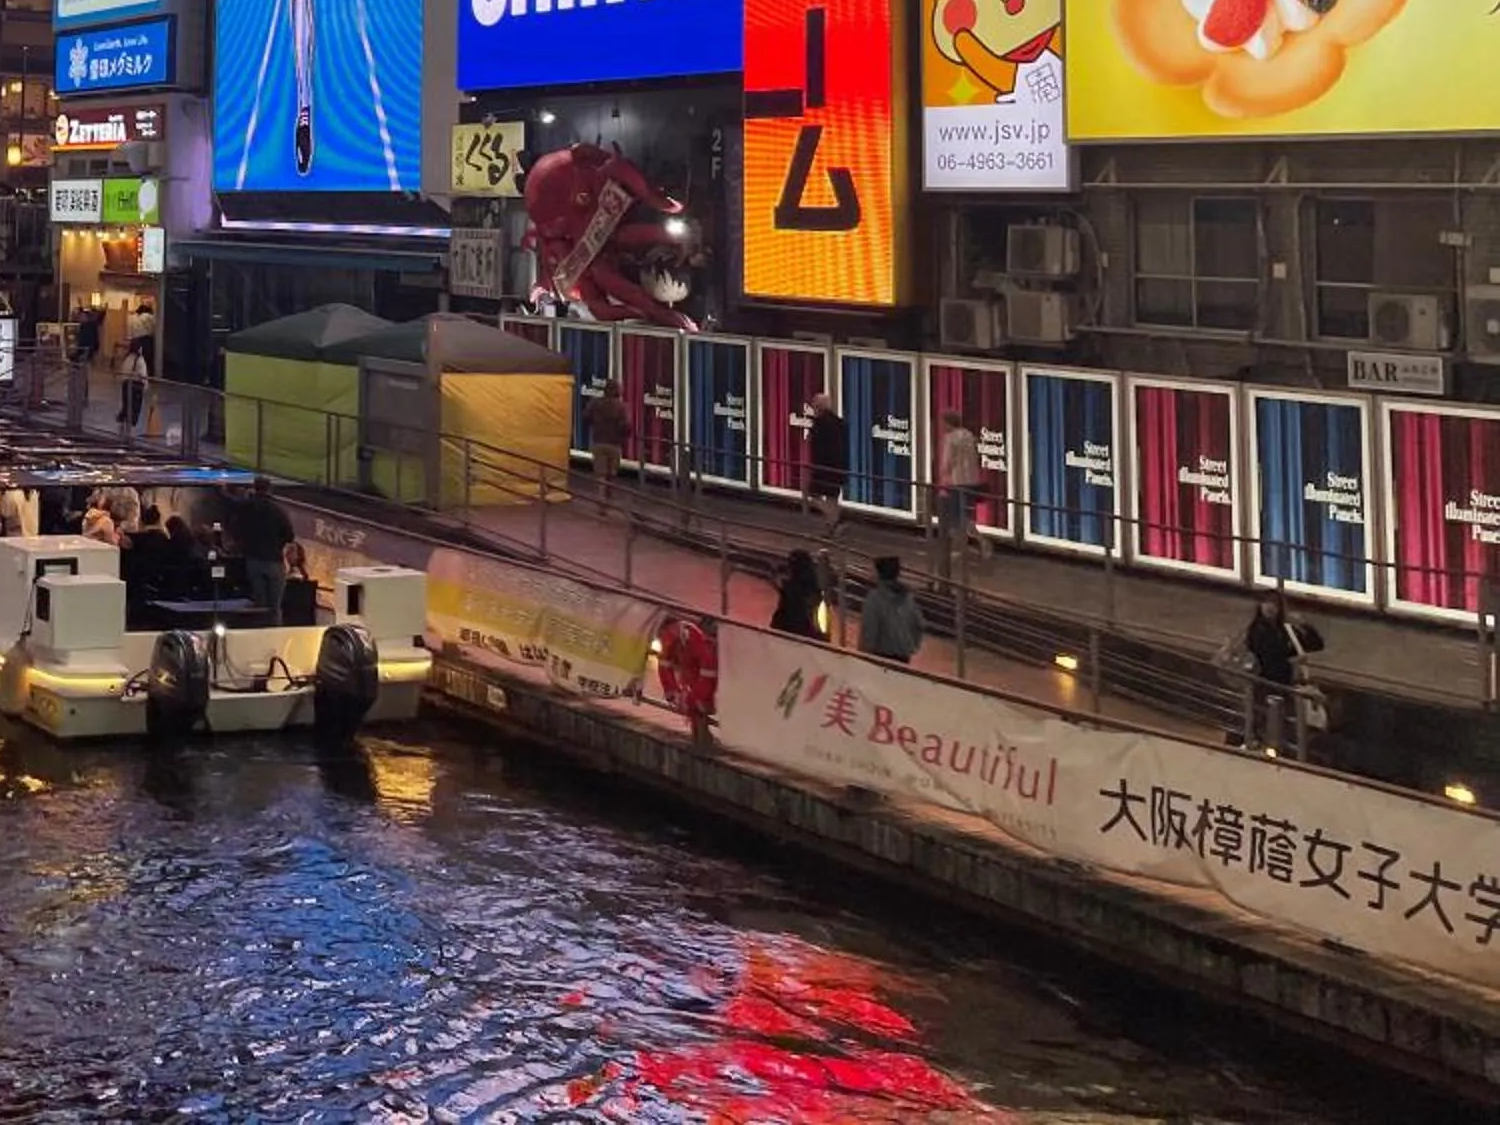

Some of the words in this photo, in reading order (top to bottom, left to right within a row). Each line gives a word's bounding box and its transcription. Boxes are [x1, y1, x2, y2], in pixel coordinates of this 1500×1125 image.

[939, 119, 1051, 145] www.jsv.jp
[937, 151, 1054, 171] 06-4963-3661
[1353, 360, 1399, 382] BAR
[1328, 471, 1358, 490] Street
[1470, 488, 1500, 510] Stree
[820, 686, 858, 738] 美
[867, 704, 1058, 806] Beautiful
